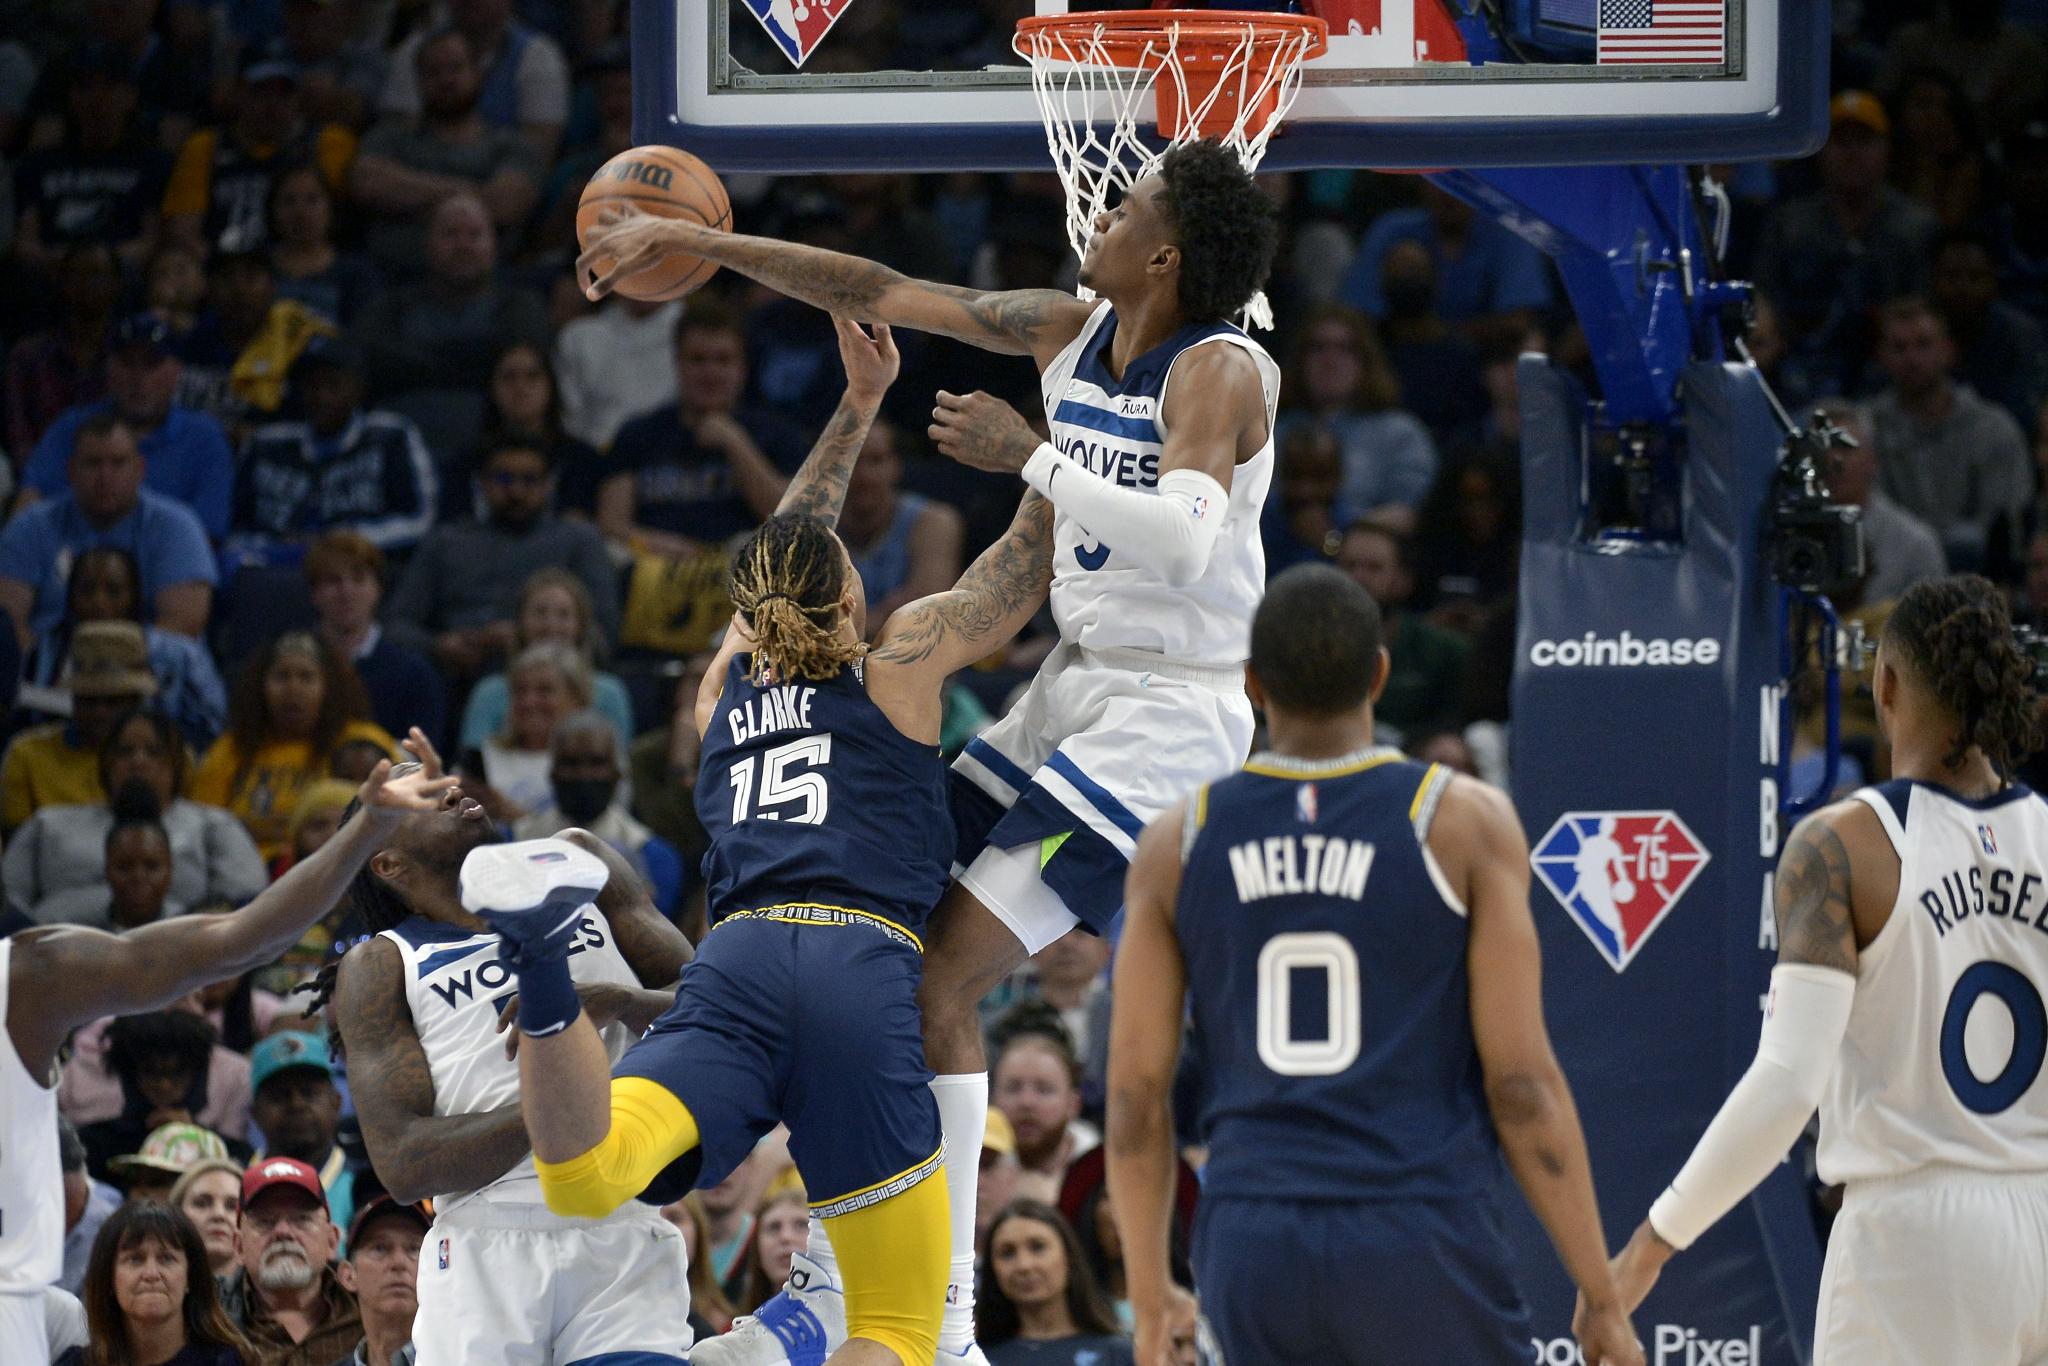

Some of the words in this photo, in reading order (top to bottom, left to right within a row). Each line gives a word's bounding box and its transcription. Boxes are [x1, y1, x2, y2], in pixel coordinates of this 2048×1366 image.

[1530, 630, 1721, 667] coinbase
[728, 685, 816, 746] CLARKE
[730, 732, 832, 826] 15
[1229, 834, 1376, 903] MELTON
[1633, 833, 1669, 881] 75
[1257, 931, 1361, 1076] 0
[1940, 960, 2048, 1115] 0
[1655, 1324, 1761, 1366] Pixel
